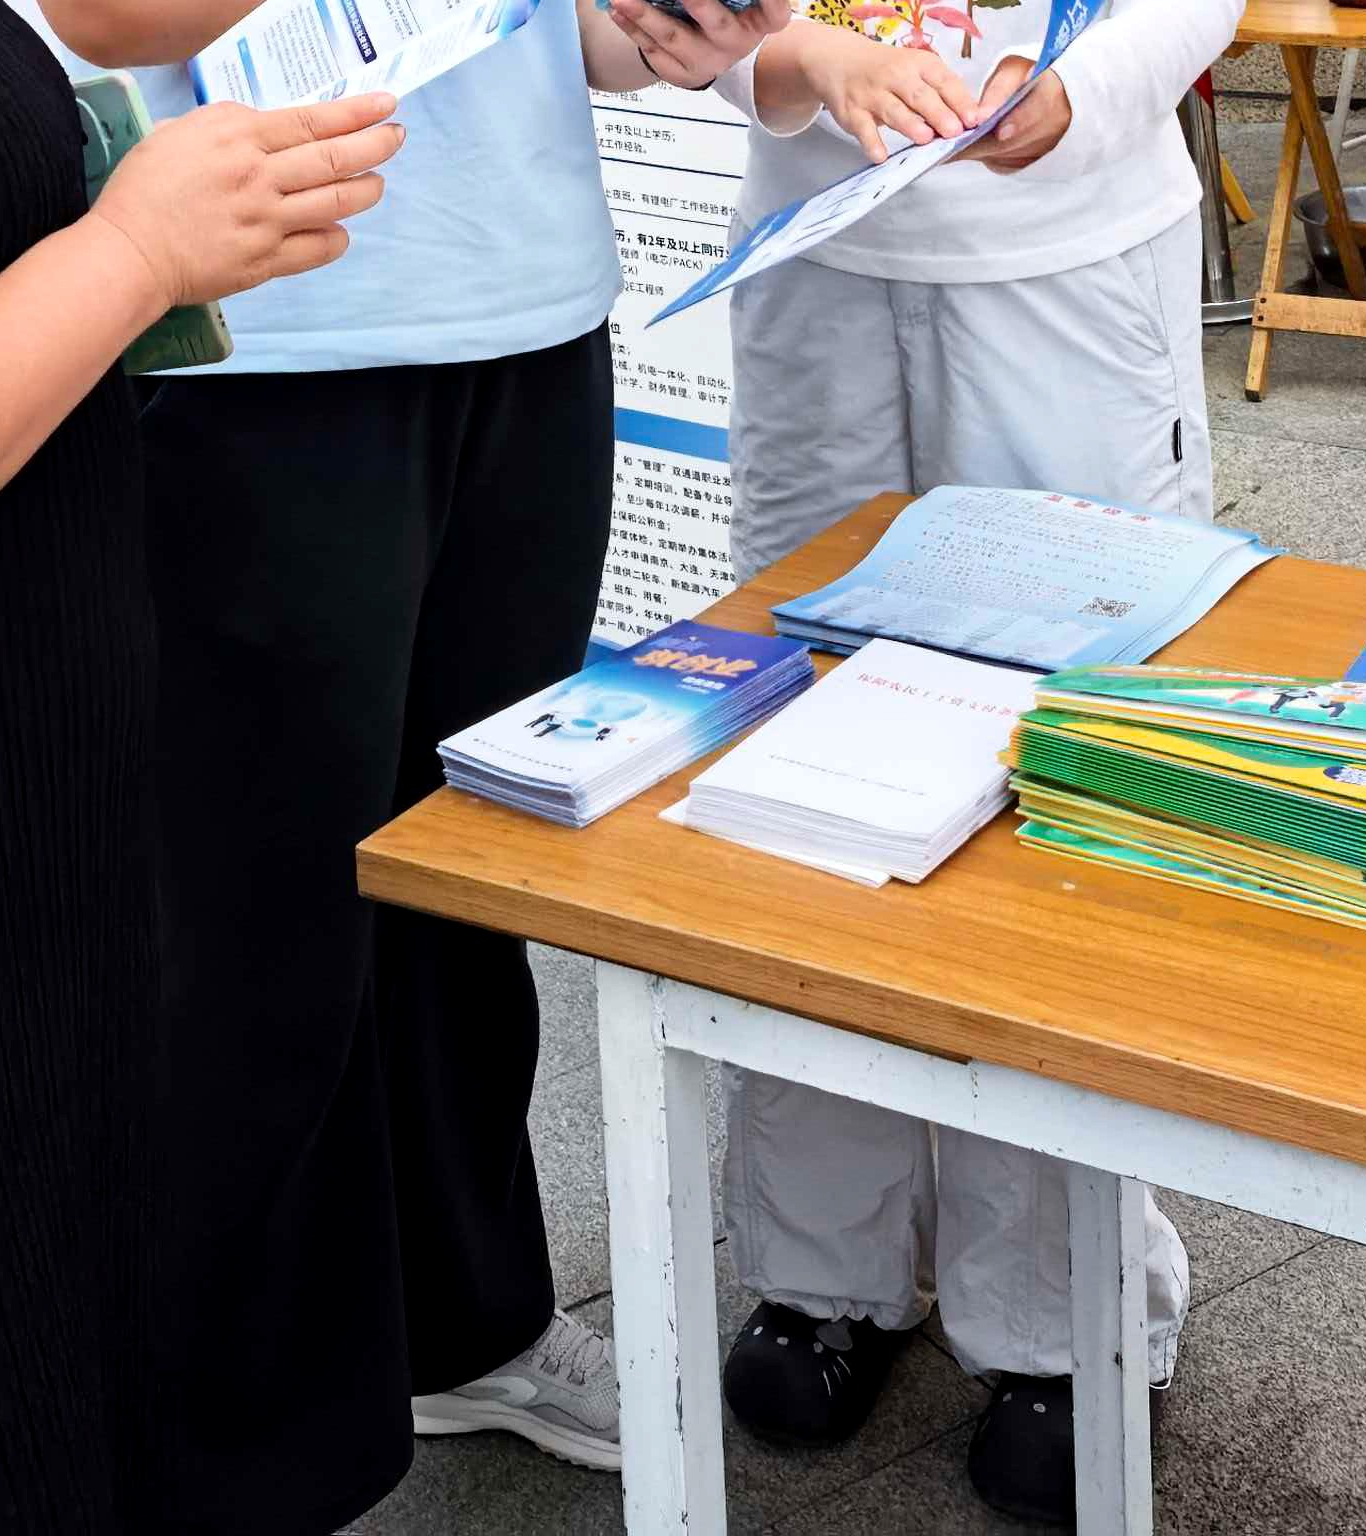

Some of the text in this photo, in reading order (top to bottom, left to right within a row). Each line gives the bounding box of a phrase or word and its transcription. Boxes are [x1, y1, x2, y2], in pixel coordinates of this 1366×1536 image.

[615, 228, 732, 261] 历，有2年及以上同行
